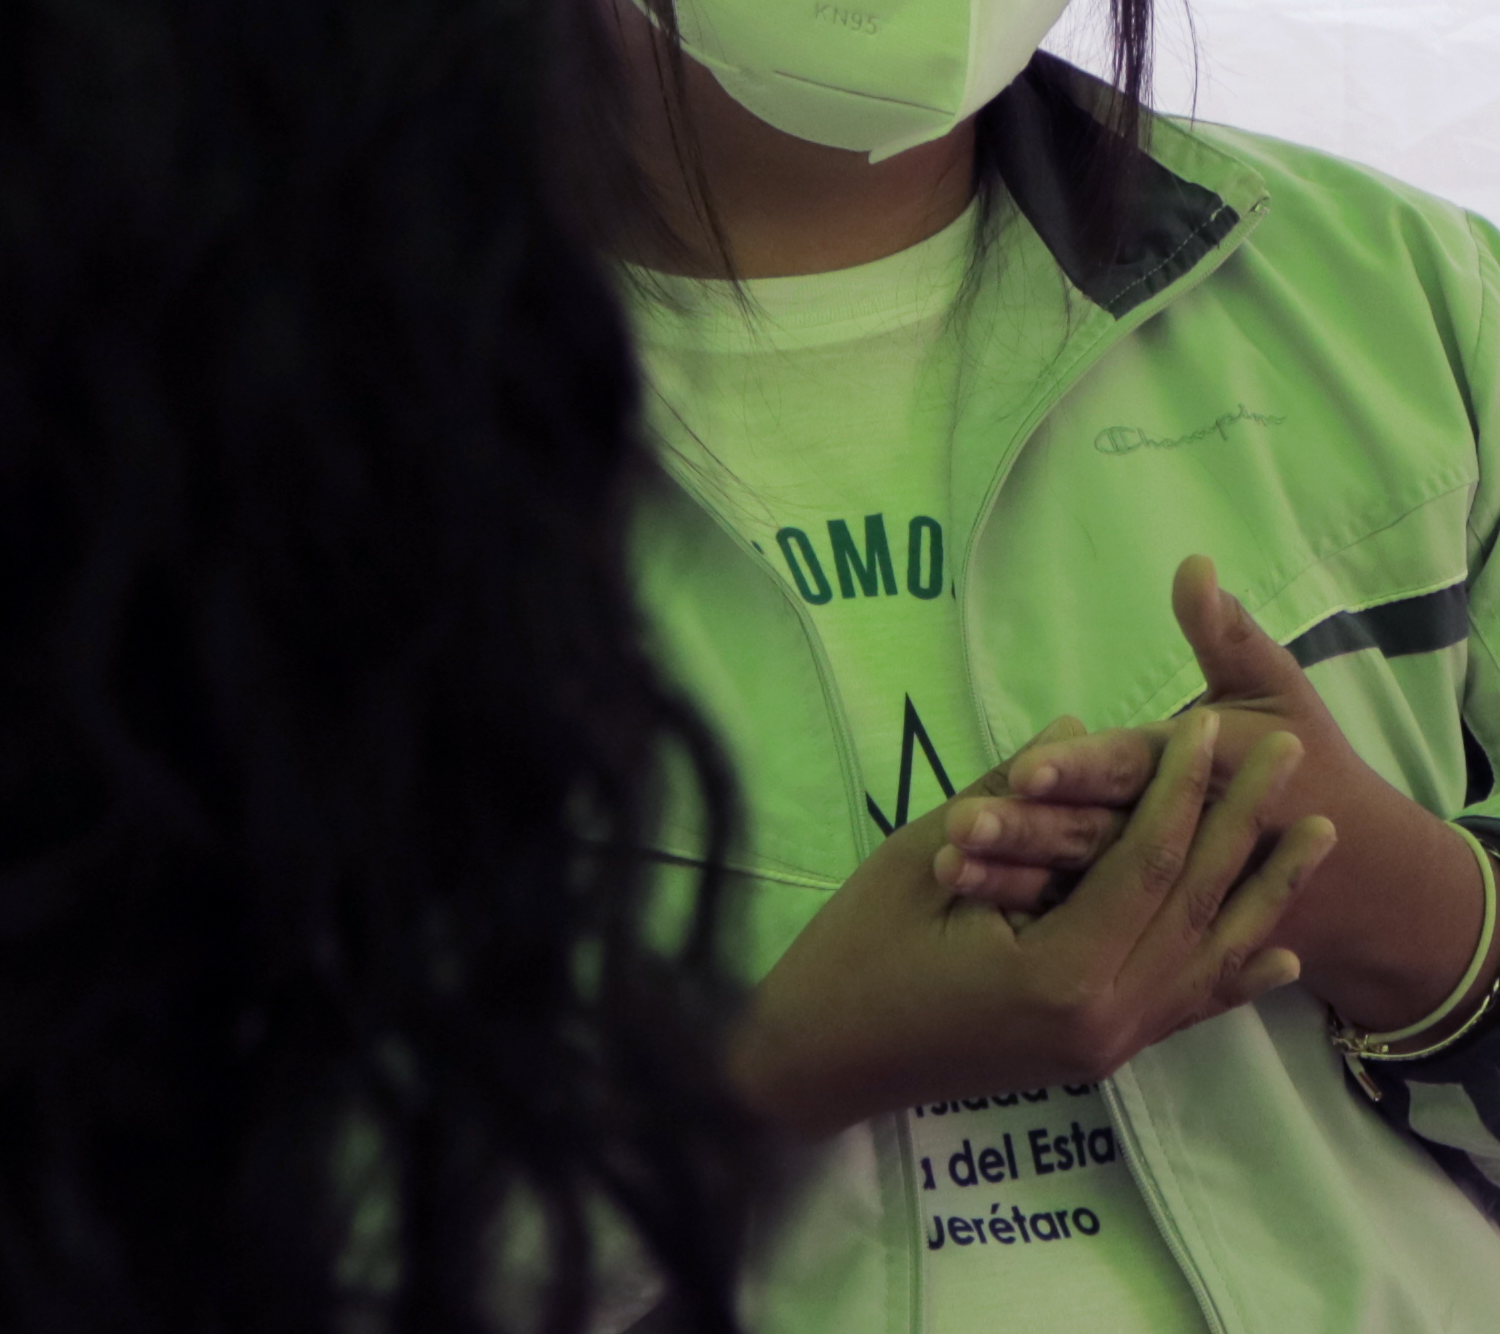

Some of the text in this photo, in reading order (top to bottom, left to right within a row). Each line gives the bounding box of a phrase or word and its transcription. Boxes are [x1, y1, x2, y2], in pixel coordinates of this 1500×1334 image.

[814, 0, 879, 36] KN95
[752, 513, 956, 605] OMO
[949, 1132, 1019, 1187] del
[1028, 1121, 1116, 1175] Esta
